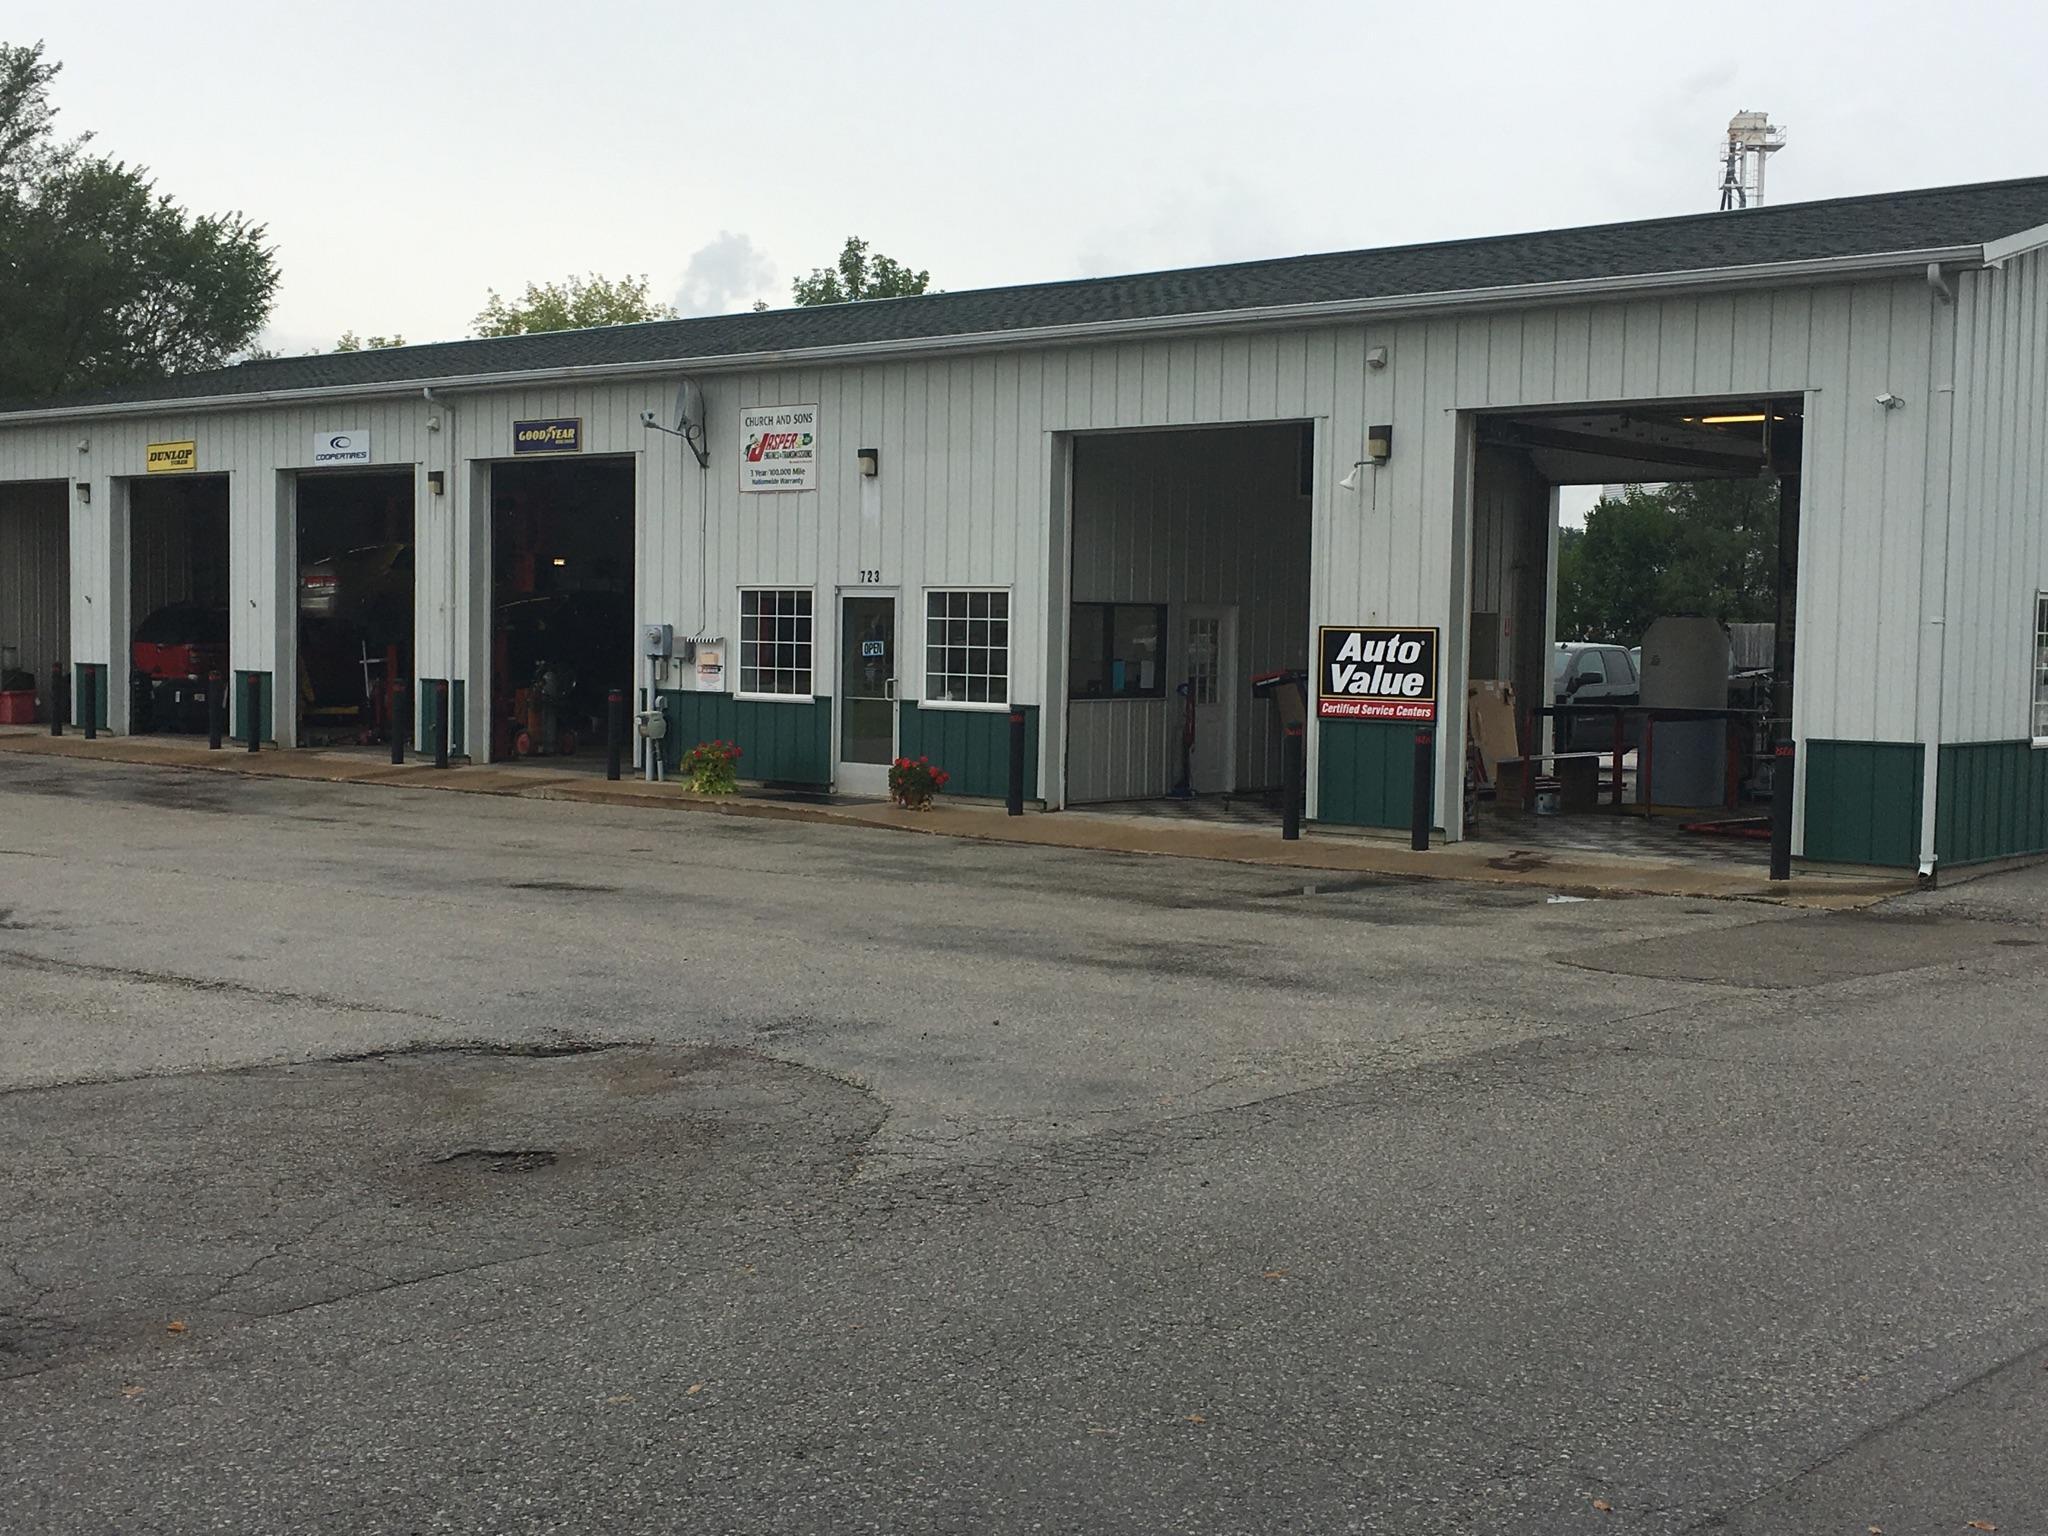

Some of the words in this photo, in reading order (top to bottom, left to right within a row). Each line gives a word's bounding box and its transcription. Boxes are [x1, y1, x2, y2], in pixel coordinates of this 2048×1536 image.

[745, 416, 774, 427] CHURCH
[776, 414, 791, 425] AND
[794, 413, 813, 424] SONS
[748, 433, 799, 462] JASPER
[149, 449, 192, 462] DUNLOP
[860, 570, 880, 583] 723
[864, 642, 882, 655] OPEN
[1336, 632, 1421, 664] Auto
[1331, 663, 1425, 696] Value
[1322, 702, 1360, 715] Certified
[1361, 704, 1395, 716] Service
[1396, 705, 1431, 718] Centers
